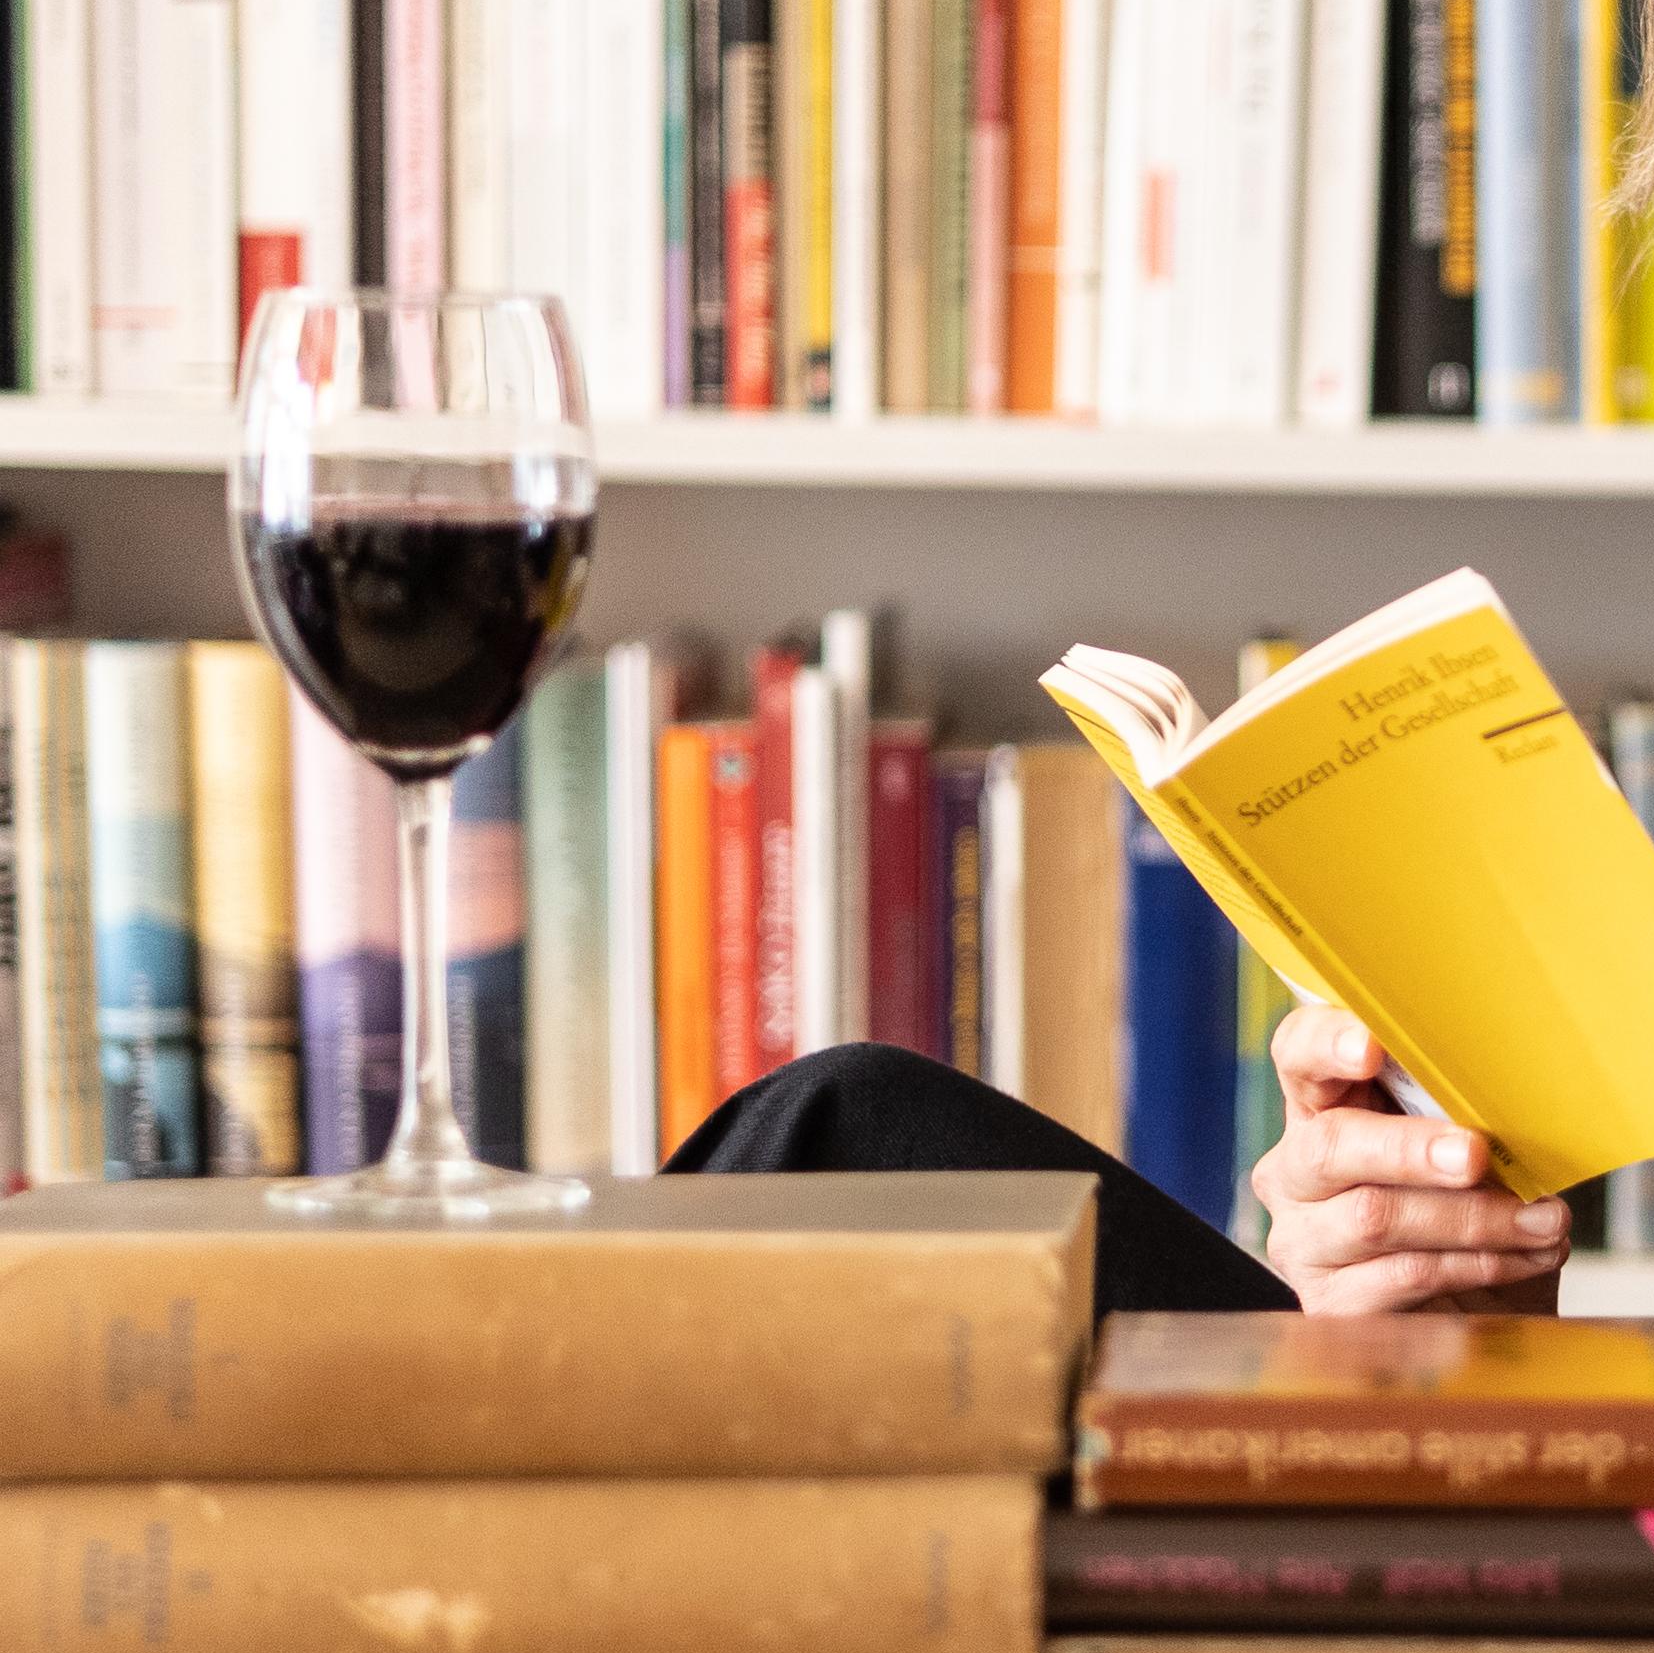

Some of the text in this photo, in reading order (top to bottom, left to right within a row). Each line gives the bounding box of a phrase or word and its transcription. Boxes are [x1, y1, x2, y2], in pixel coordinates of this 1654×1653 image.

[1339, 664, 1435, 723] Henrik
[1238, 671, 1520, 827] Stützen der Gesellschaft
[1121, 1429, 1412, 1489] amerikaner
[1540, 1429, 1627, 1492] der
